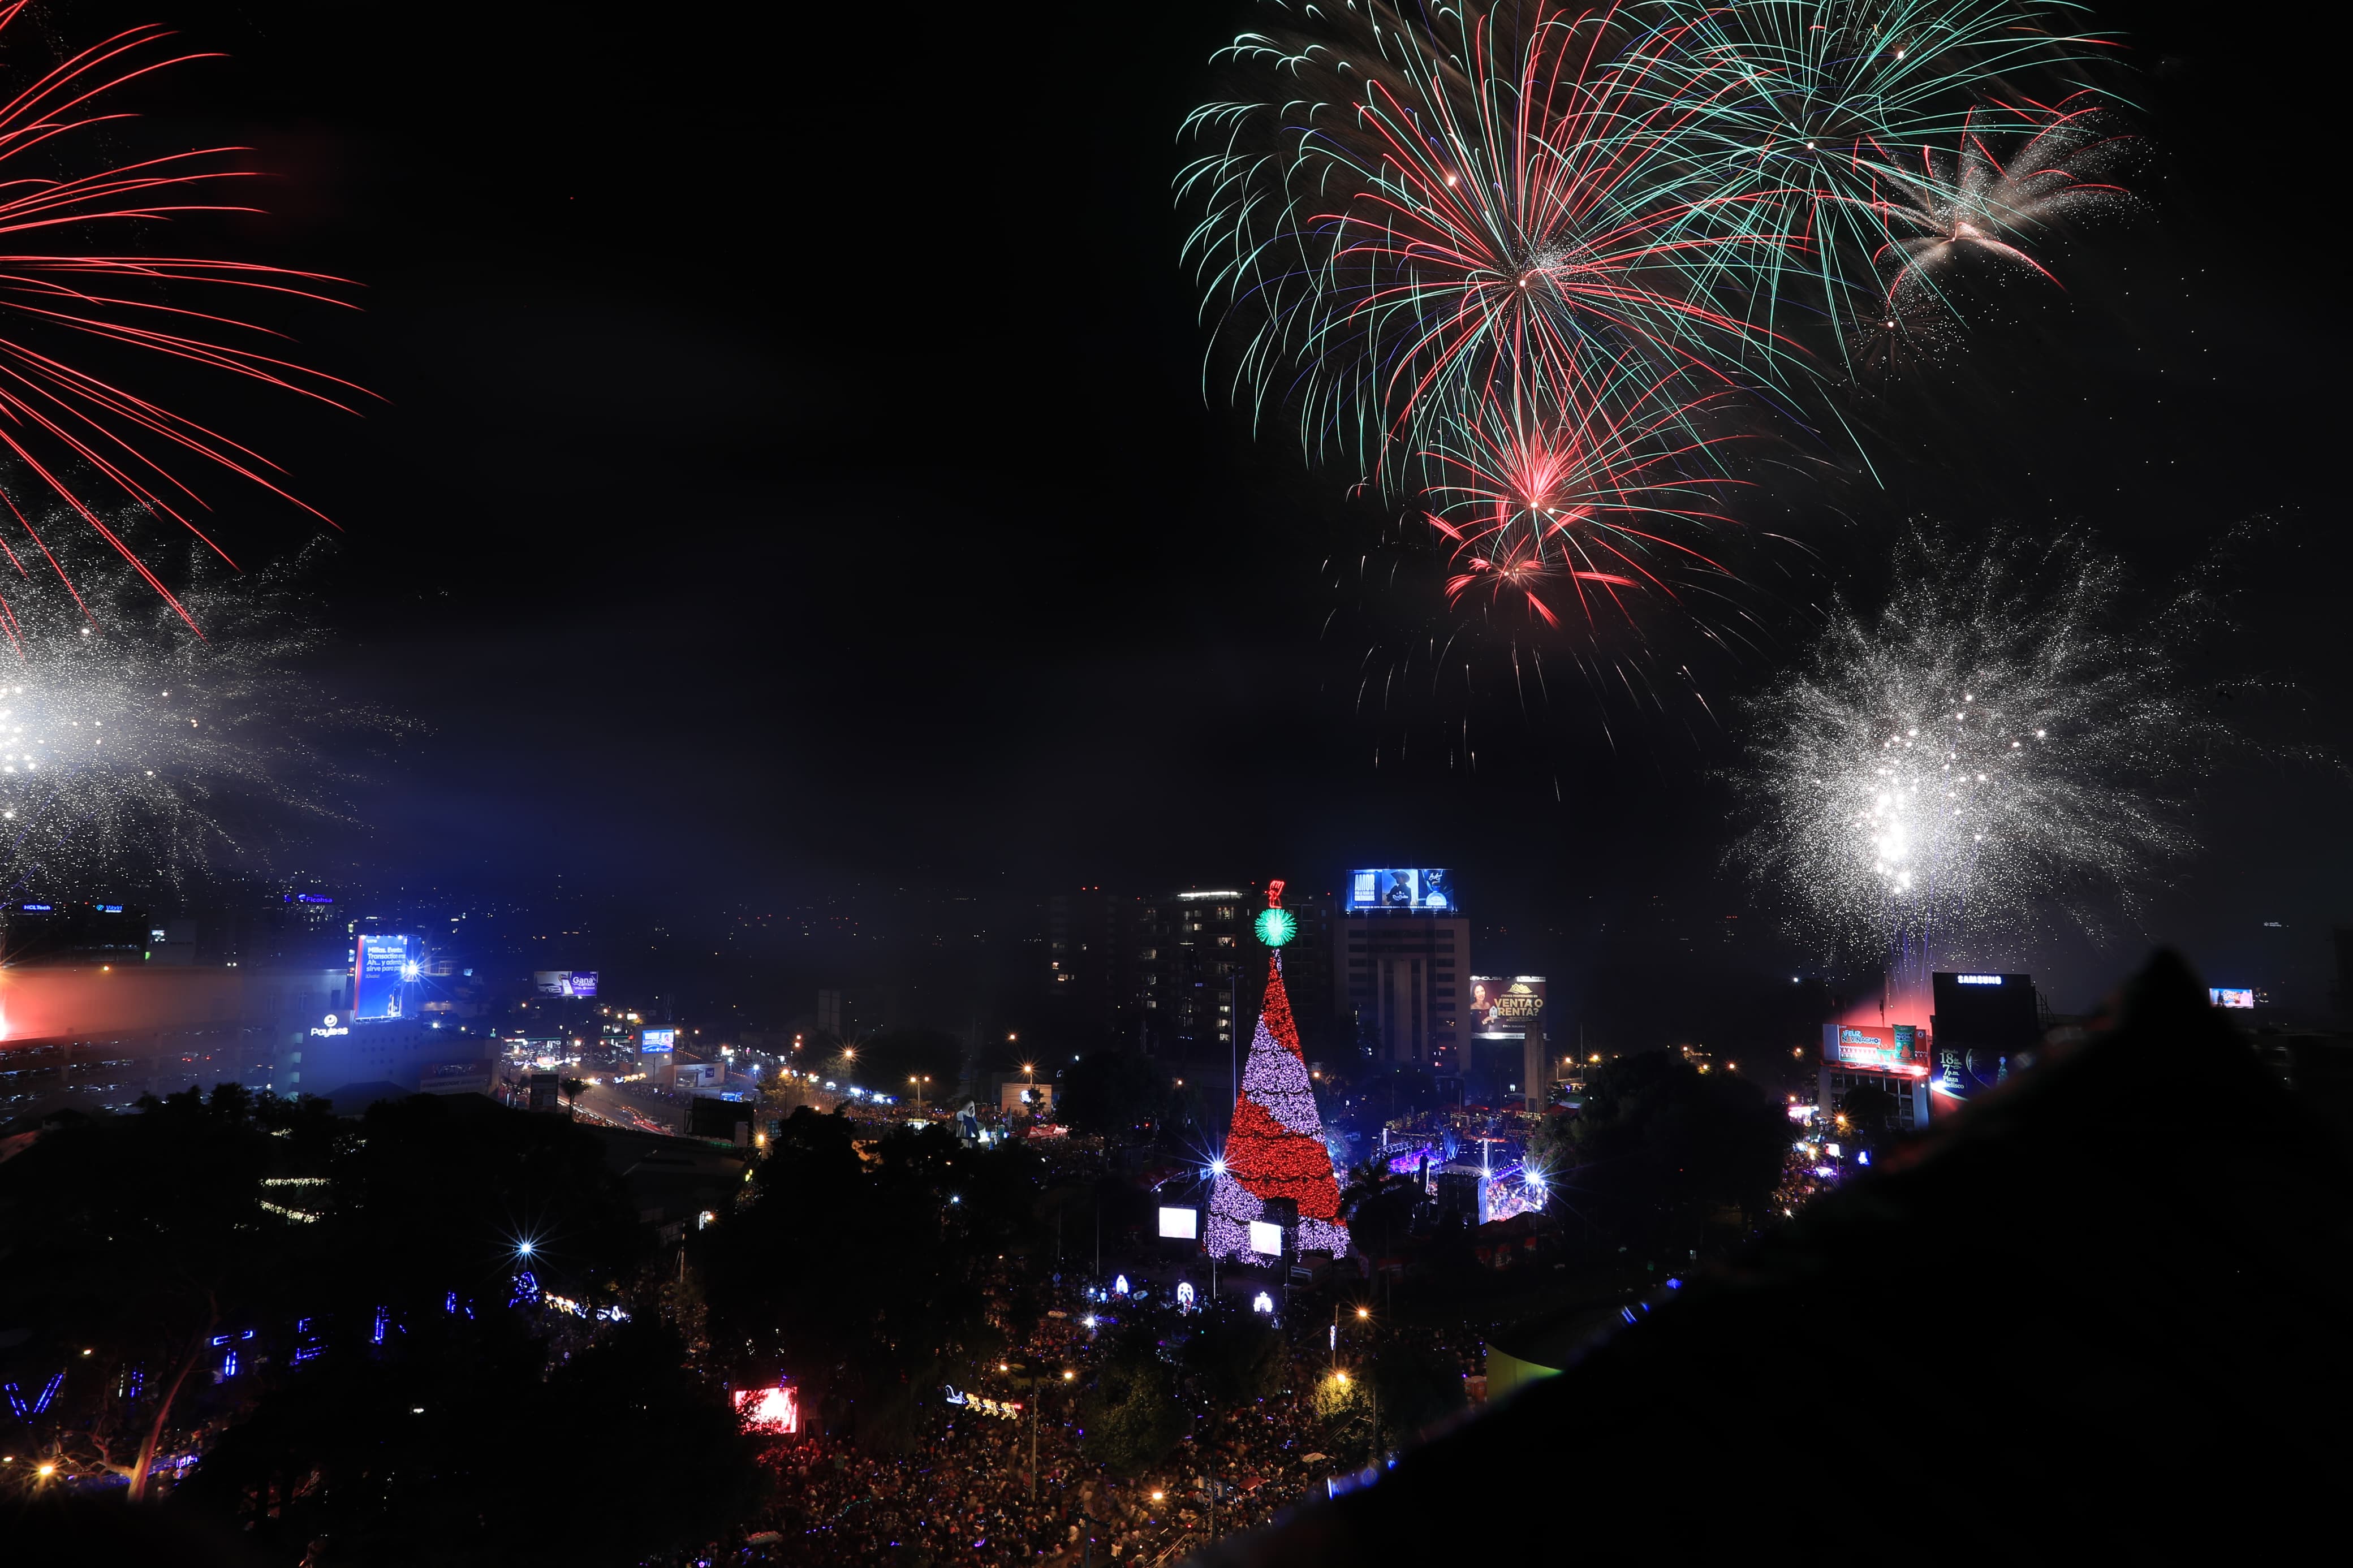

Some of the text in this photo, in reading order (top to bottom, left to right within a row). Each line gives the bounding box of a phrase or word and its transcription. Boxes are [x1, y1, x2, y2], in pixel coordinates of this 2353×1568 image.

[1355, 874, 1374, 891] AMOR
[1957, 975, 2002, 985] SAMSUNG
[1493, 998, 1544, 1008] VENTA O
[310, 1027, 348, 1038] Payless
[1939, 1052, 1954, 1064] 18
[1942, 1064, 1950, 1076] 7
